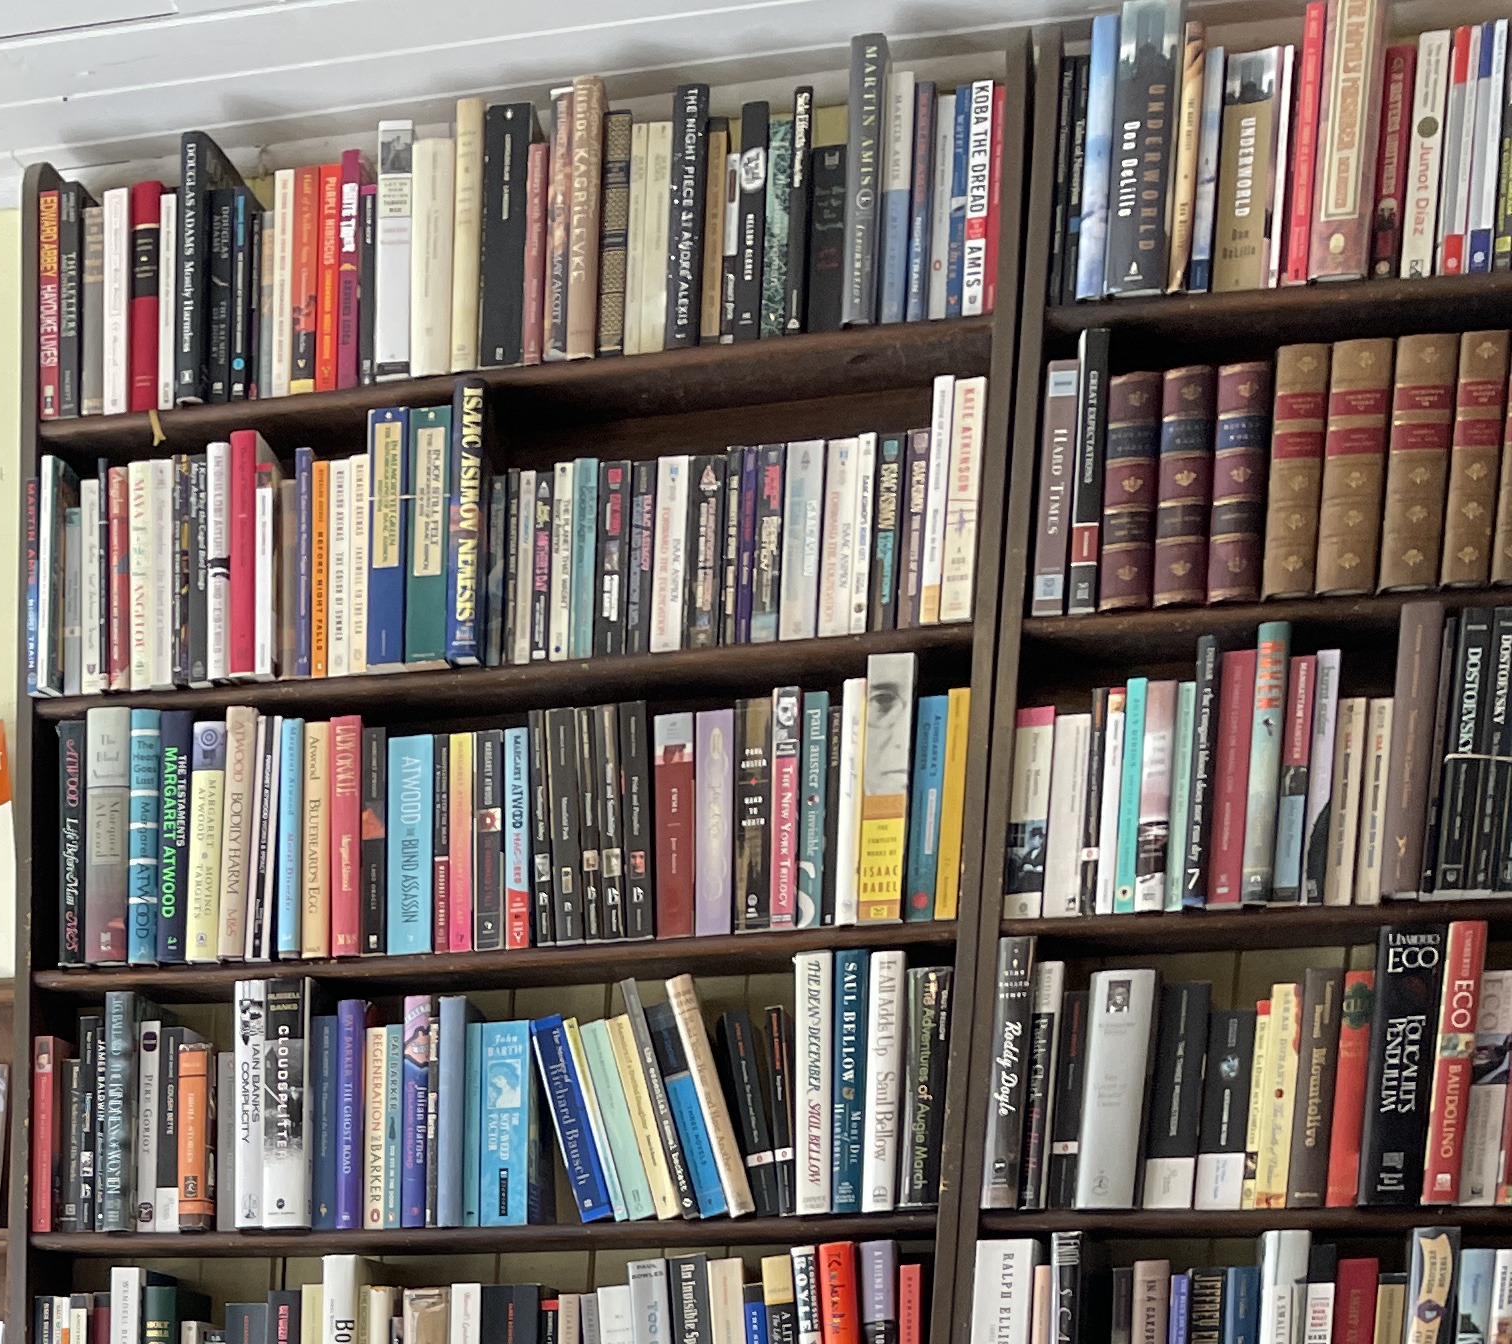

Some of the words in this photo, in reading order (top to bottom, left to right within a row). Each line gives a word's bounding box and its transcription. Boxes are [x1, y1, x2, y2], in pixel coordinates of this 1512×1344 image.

[974, 84, 990, 129] KOBA
[185, 143, 196, 198] DOUGLAS
[972, 131, 988, 159] THE
[1236, 116, 1256, 218] UNDERWORLD
[969, 161, 988, 214] DREAD
[184, 200, 195, 255] ADAMS
[965, 244, 983, 289] AMIS
[462, 387, 483, 450] ISAAC
[460, 452, 481, 534] ASIMOV
[1458, 646, 1483, 755] DOSTOEVSKY
[162, 746, 179, 839] MARGARET
[400, 755, 421, 825] ATWOOD
[161, 841, 177, 918] ATWOOD
[401, 839, 419, 868] BLIND
[401, 870, 419, 924] ASSASSIN
[842, 962, 858, 1004] SAUL
[1387, 946, 1440, 973] ECO
[842, 1006, 857, 1086] BELLOW
[1003, 1020, 1024, 1067] Roddy
[275, 1025, 290, 1159] CLOUDSPLITTER
[998, 1070, 1020, 1117] Doyle
